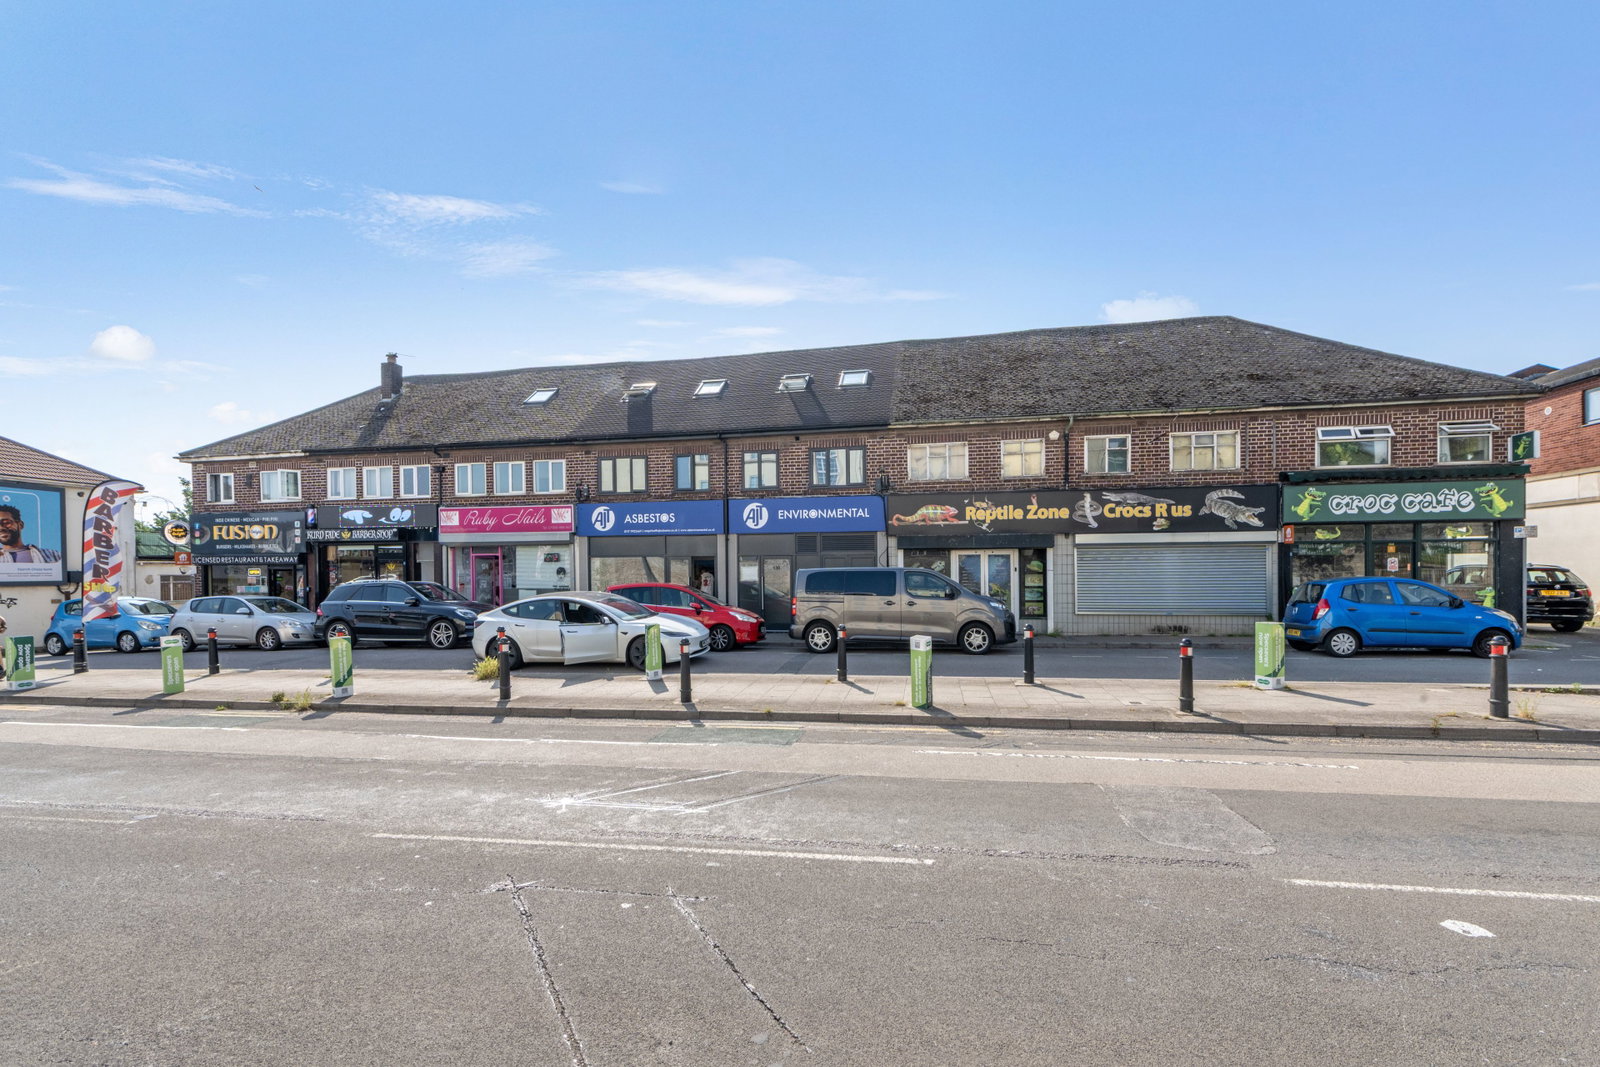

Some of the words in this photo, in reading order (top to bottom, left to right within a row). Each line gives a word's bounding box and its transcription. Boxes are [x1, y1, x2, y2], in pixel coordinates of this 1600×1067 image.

[624, 513, 675, 523] ASBESTOS
[778, 508, 869, 519] ENVIRONMENTAL
[965, 503, 1023, 523] Reptile
[1026, 504, 1070, 520] Zone
[1103, 503, 1151, 518] Crocs
[1155, 503, 1167, 518] R
[1170, 503, 1192, 517] us
[463, 509, 498, 530] Ruby
[501, 508, 547, 525] Nails
[93, 487, 118, 582] BARBER
[213, 525, 279, 540] FUSION
[307, 530, 324, 539] KURD
[352, 530, 376, 539] BARBER
[376, 529, 394, 540] SHOP
[83, 582, 116, 594] SHOP
[166, 655, 174, 685] Specsavers
